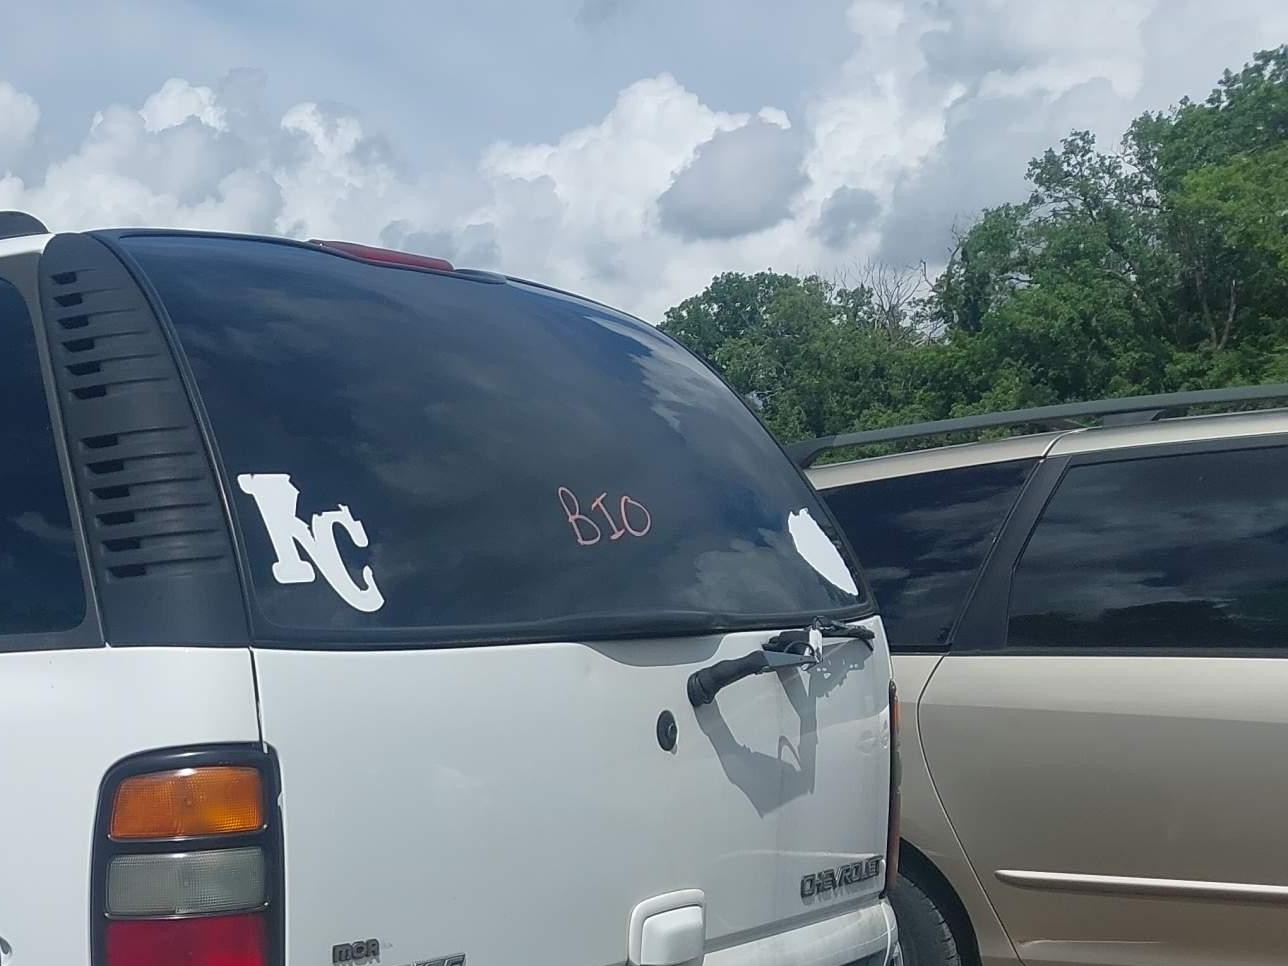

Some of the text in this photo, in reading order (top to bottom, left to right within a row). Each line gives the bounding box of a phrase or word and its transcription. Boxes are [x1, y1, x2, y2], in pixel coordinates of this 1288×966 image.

[237, 473, 385, 612] KC
[558, 486, 652, 545] BIO
[800, 855, 883, 898] CHEVROLET
